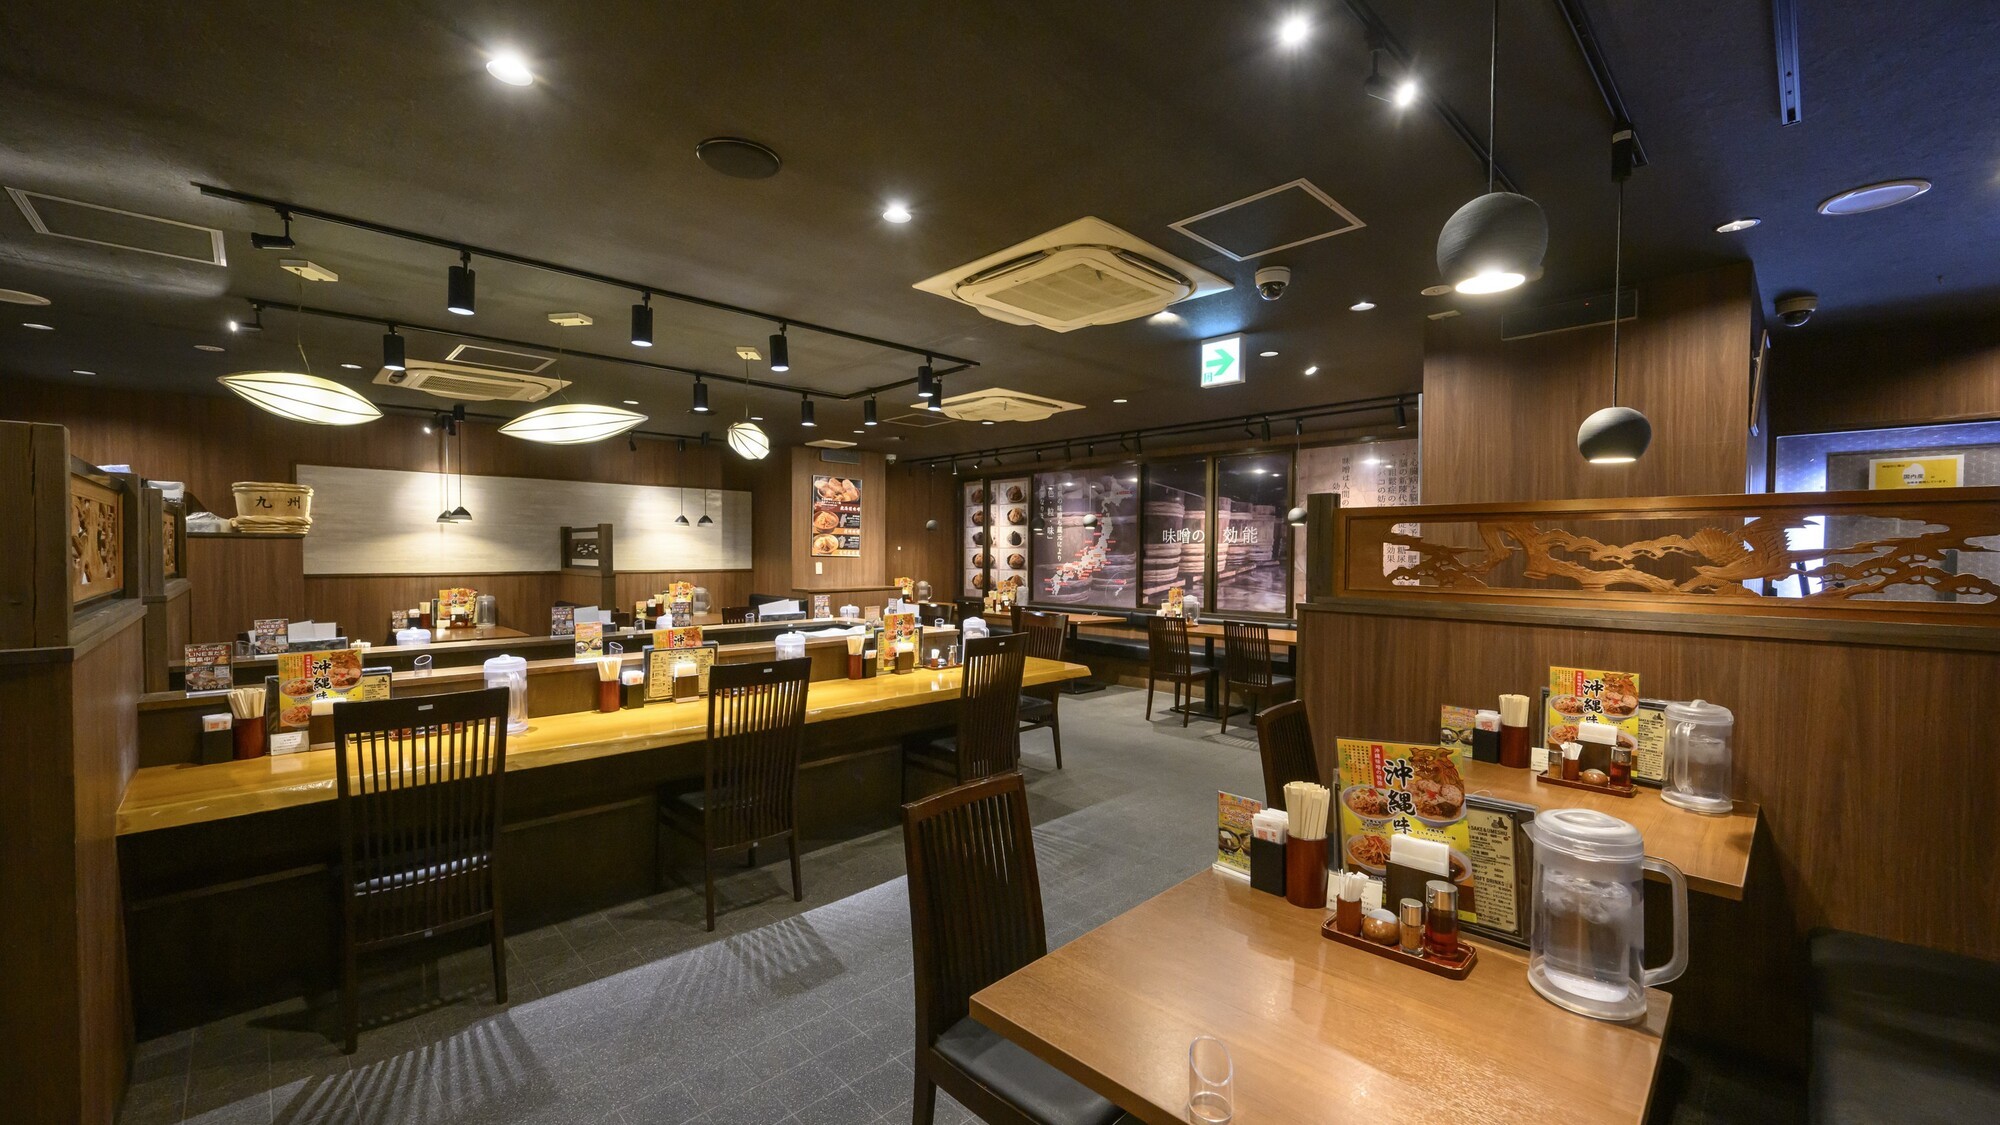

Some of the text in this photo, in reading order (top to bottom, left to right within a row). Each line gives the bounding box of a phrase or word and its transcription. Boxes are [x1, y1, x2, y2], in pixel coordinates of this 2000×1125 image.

[255, 496, 301, 509] 九州
[1162, 526, 1258, 544] 味噌の効能
[1486, 877, 1505, 886] DRINKS
